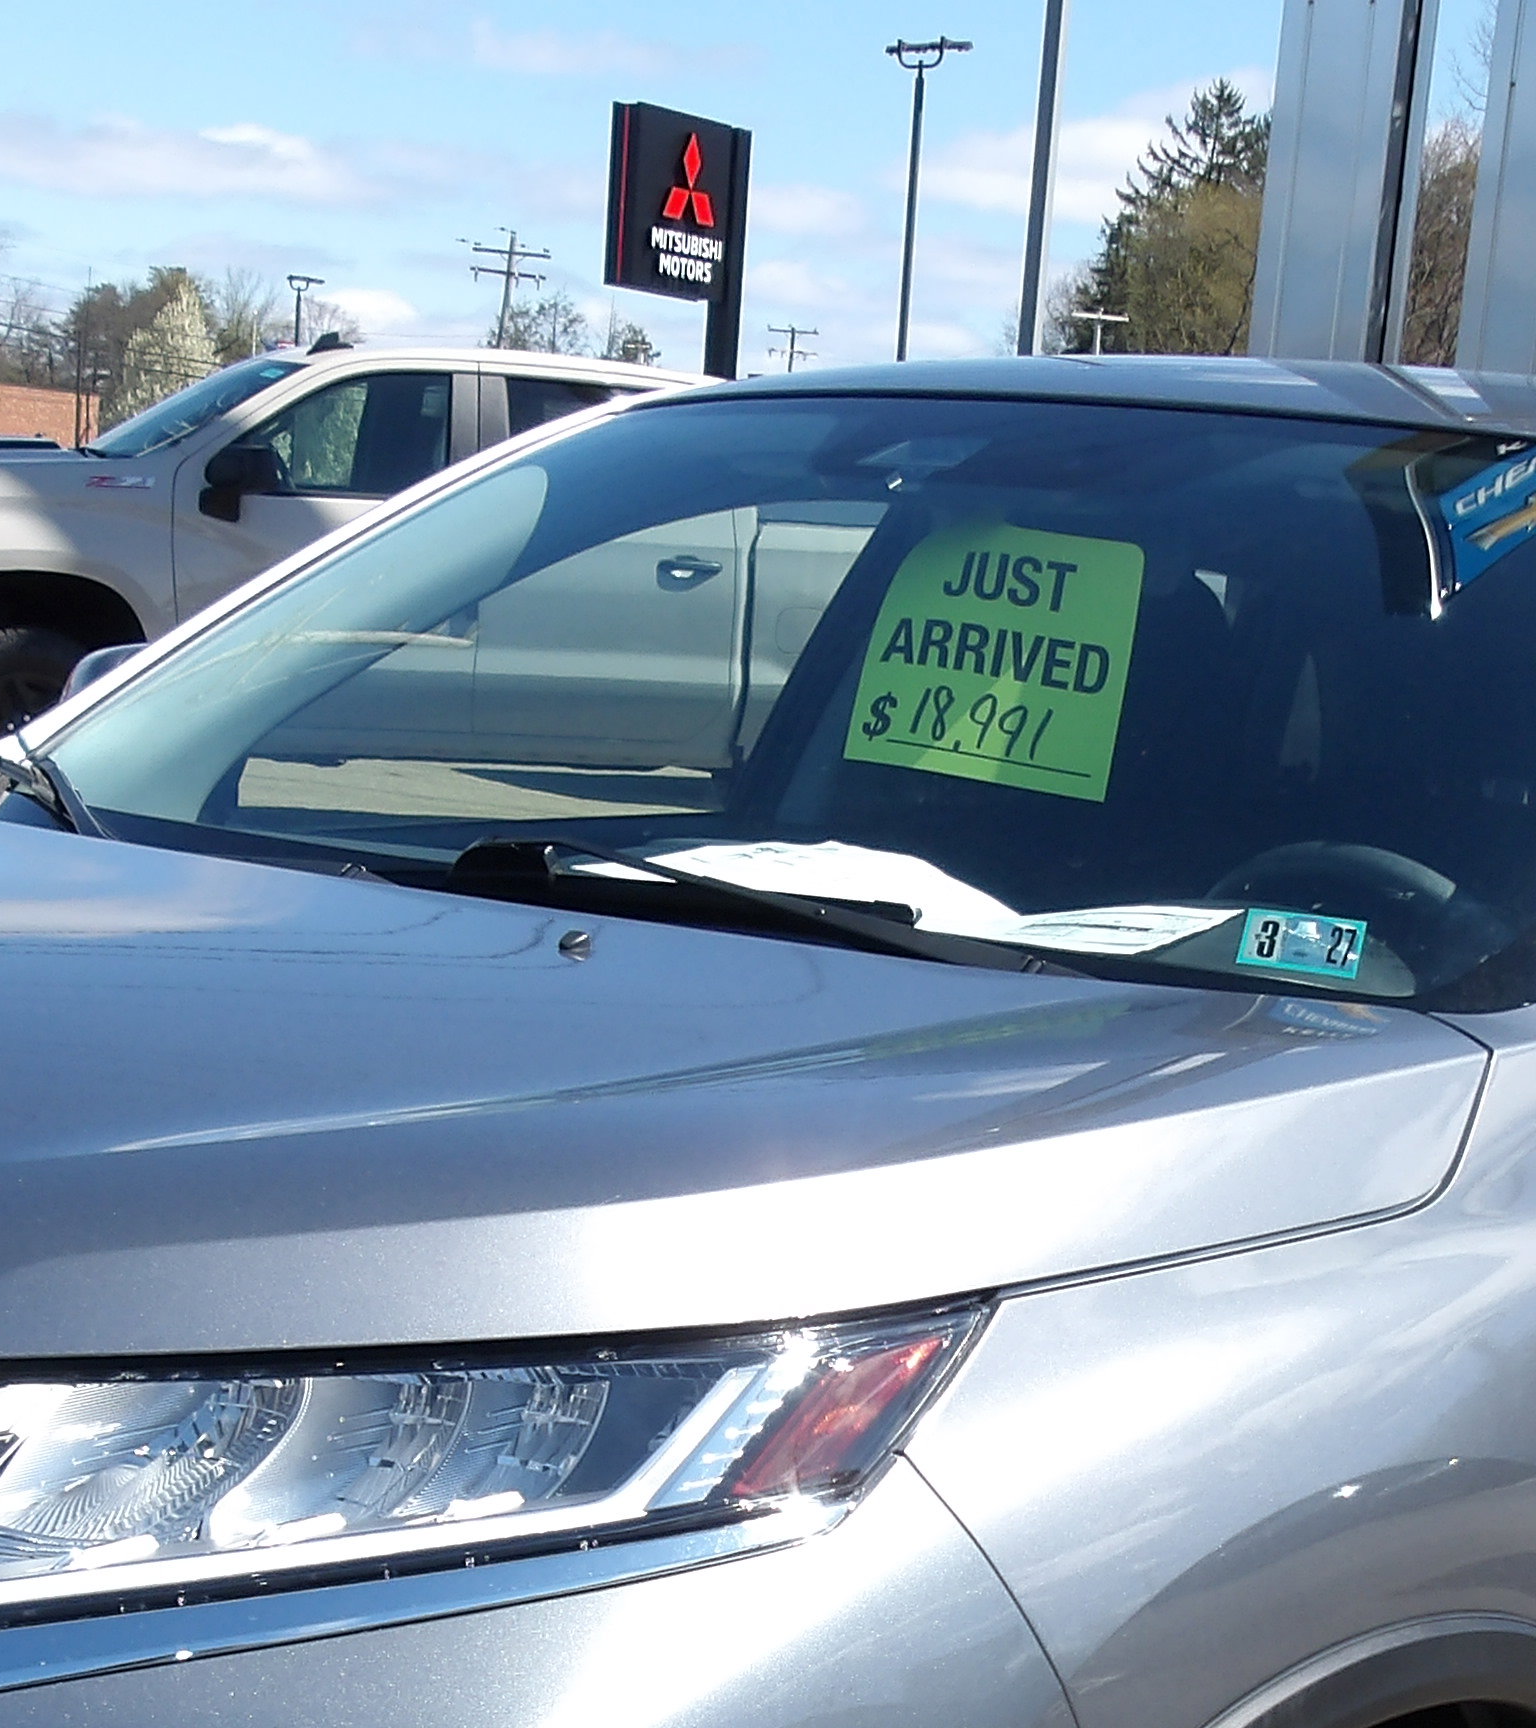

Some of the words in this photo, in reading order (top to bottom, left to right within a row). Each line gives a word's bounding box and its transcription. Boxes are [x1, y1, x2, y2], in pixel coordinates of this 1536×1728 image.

[651, 226, 723, 262] MITSUBISHI
[659, 252, 712, 284] MOTORS
[942, 551, 1078, 613] JUST
[879, 617, 1110, 695] ARRIVED
[1256, 920, 1280, 959] 3
[1326, 927, 1358, 967] 27
